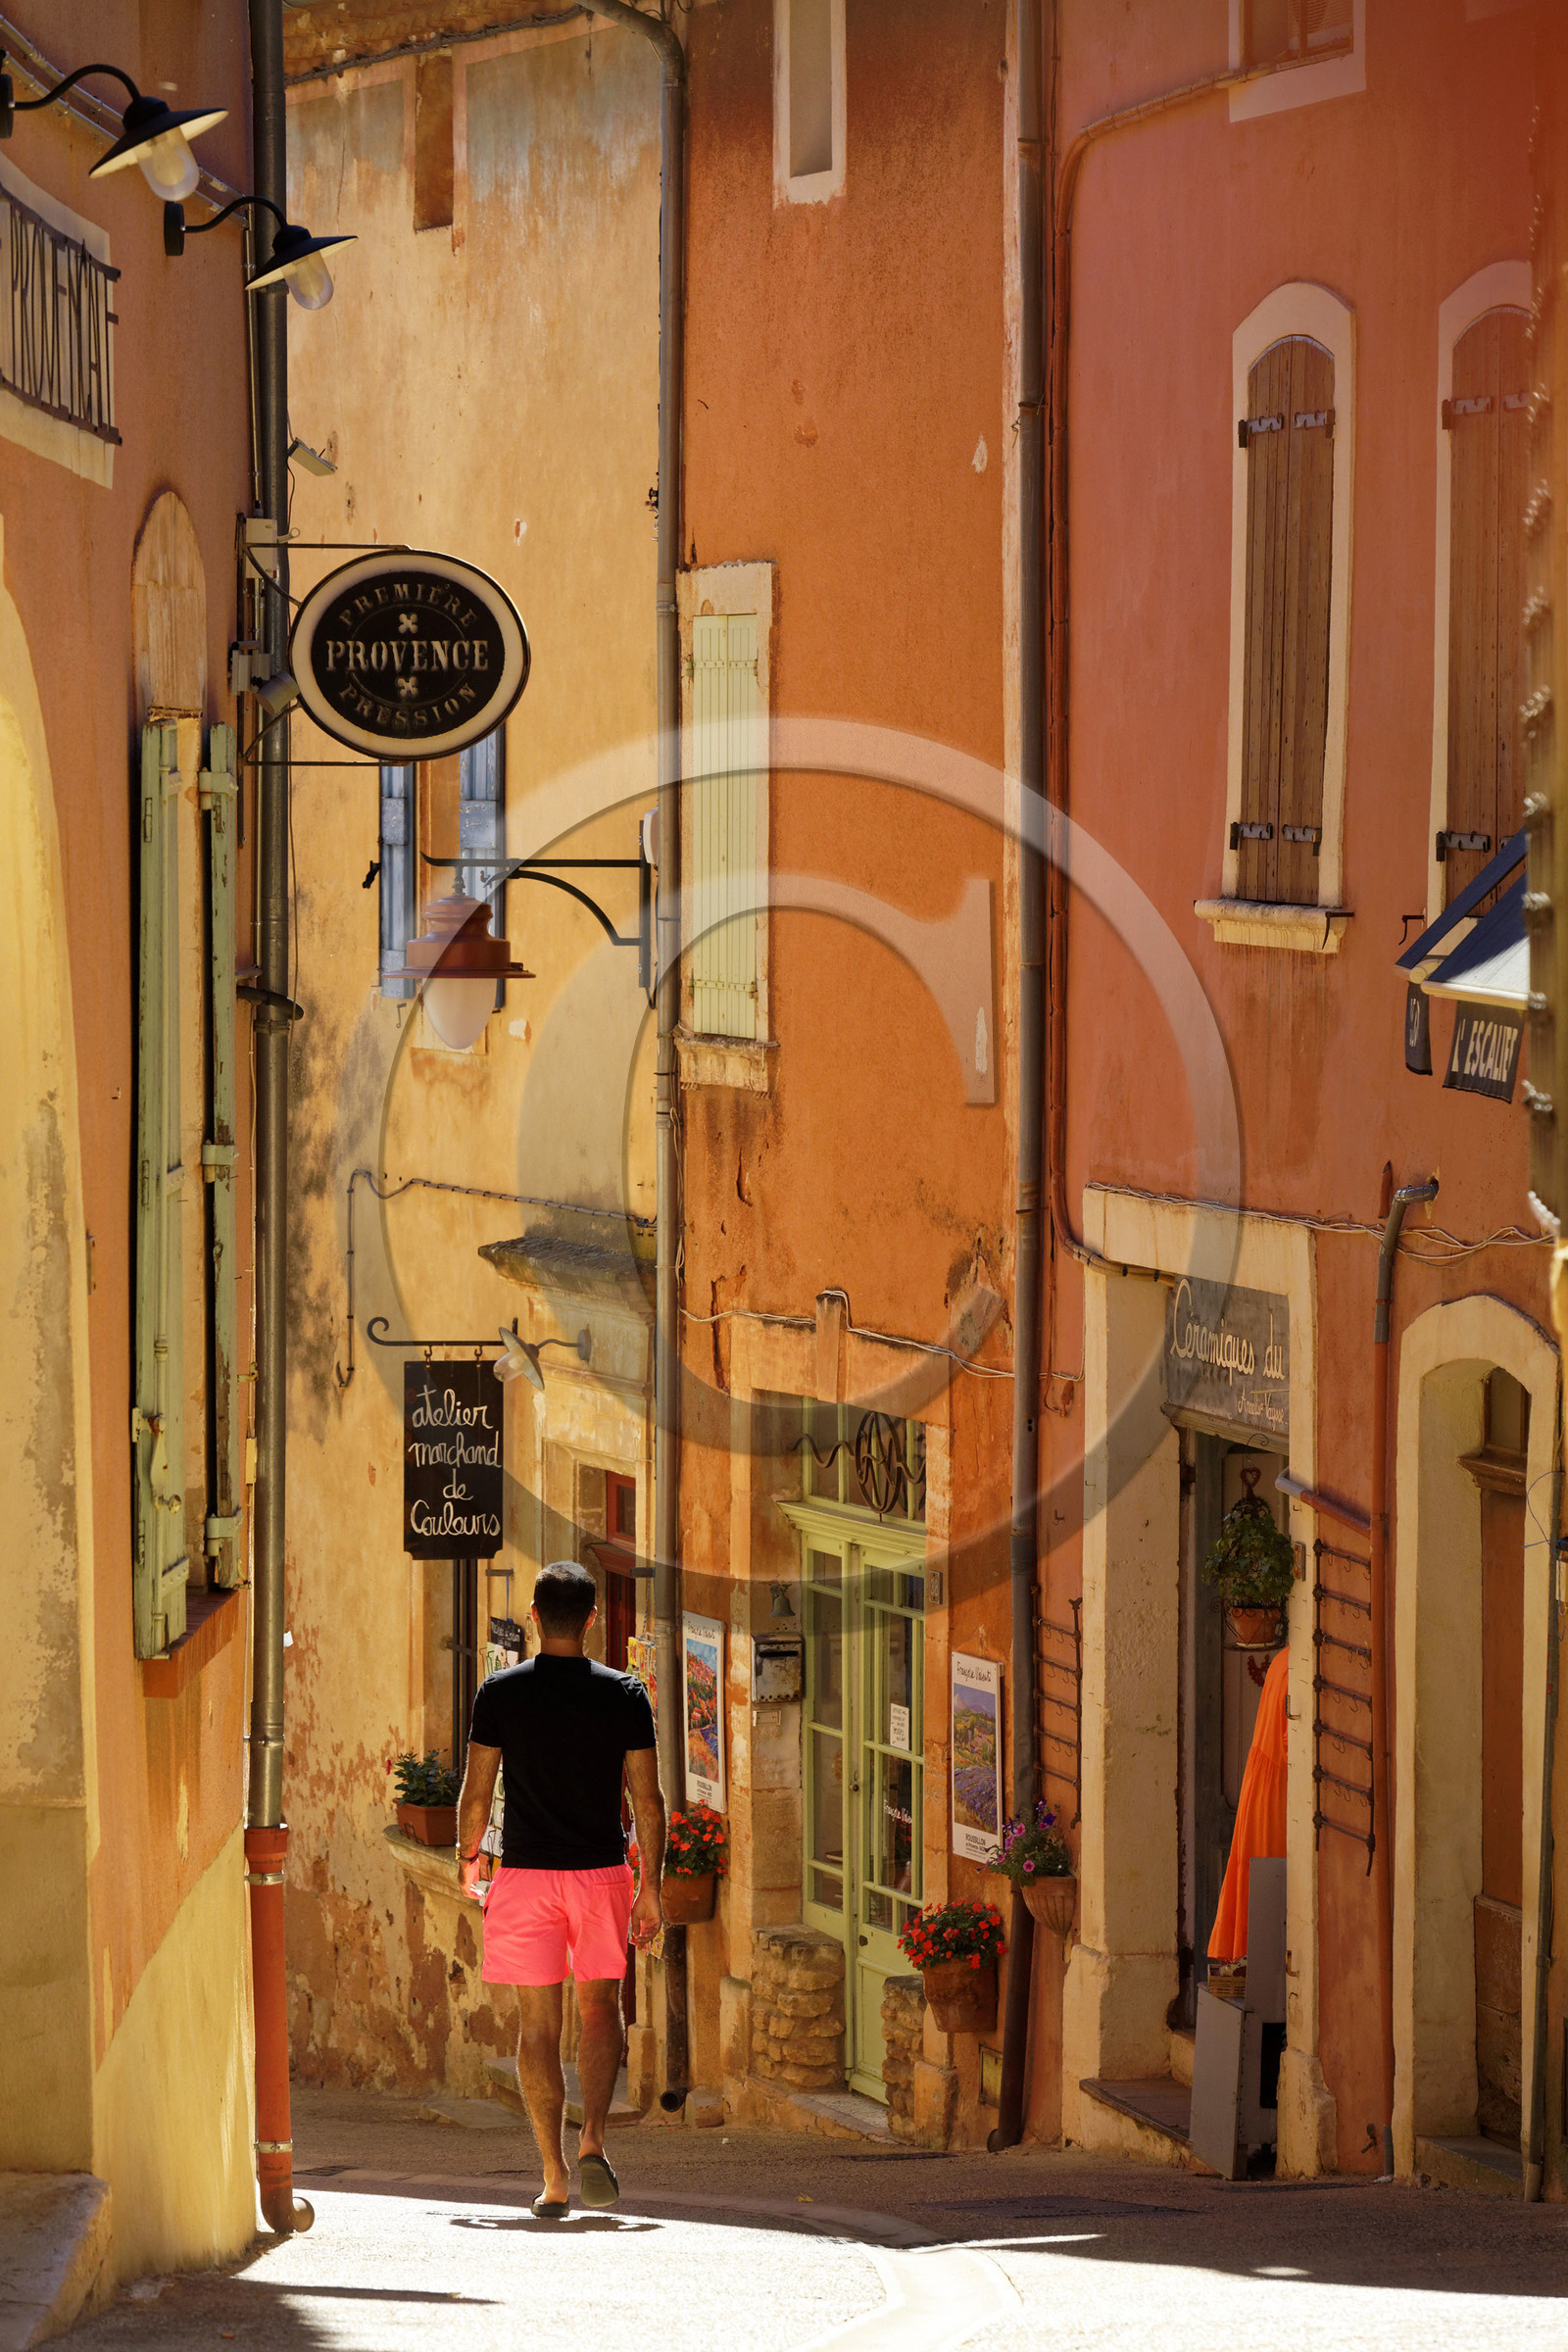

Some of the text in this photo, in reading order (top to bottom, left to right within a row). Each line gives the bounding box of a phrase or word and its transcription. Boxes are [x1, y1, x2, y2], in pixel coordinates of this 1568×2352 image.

[325, 639, 490, 673] PROVENCE
[340, 681, 477, 731] PRESSION
[1262, 1313, 1286, 1381] du
[412, 1384, 494, 1430] atelier
[408, 1430, 503, 1469] marchand
[442, 1468, 474, 1501] de
[410, 1498, 502, 1538] Couleurs
